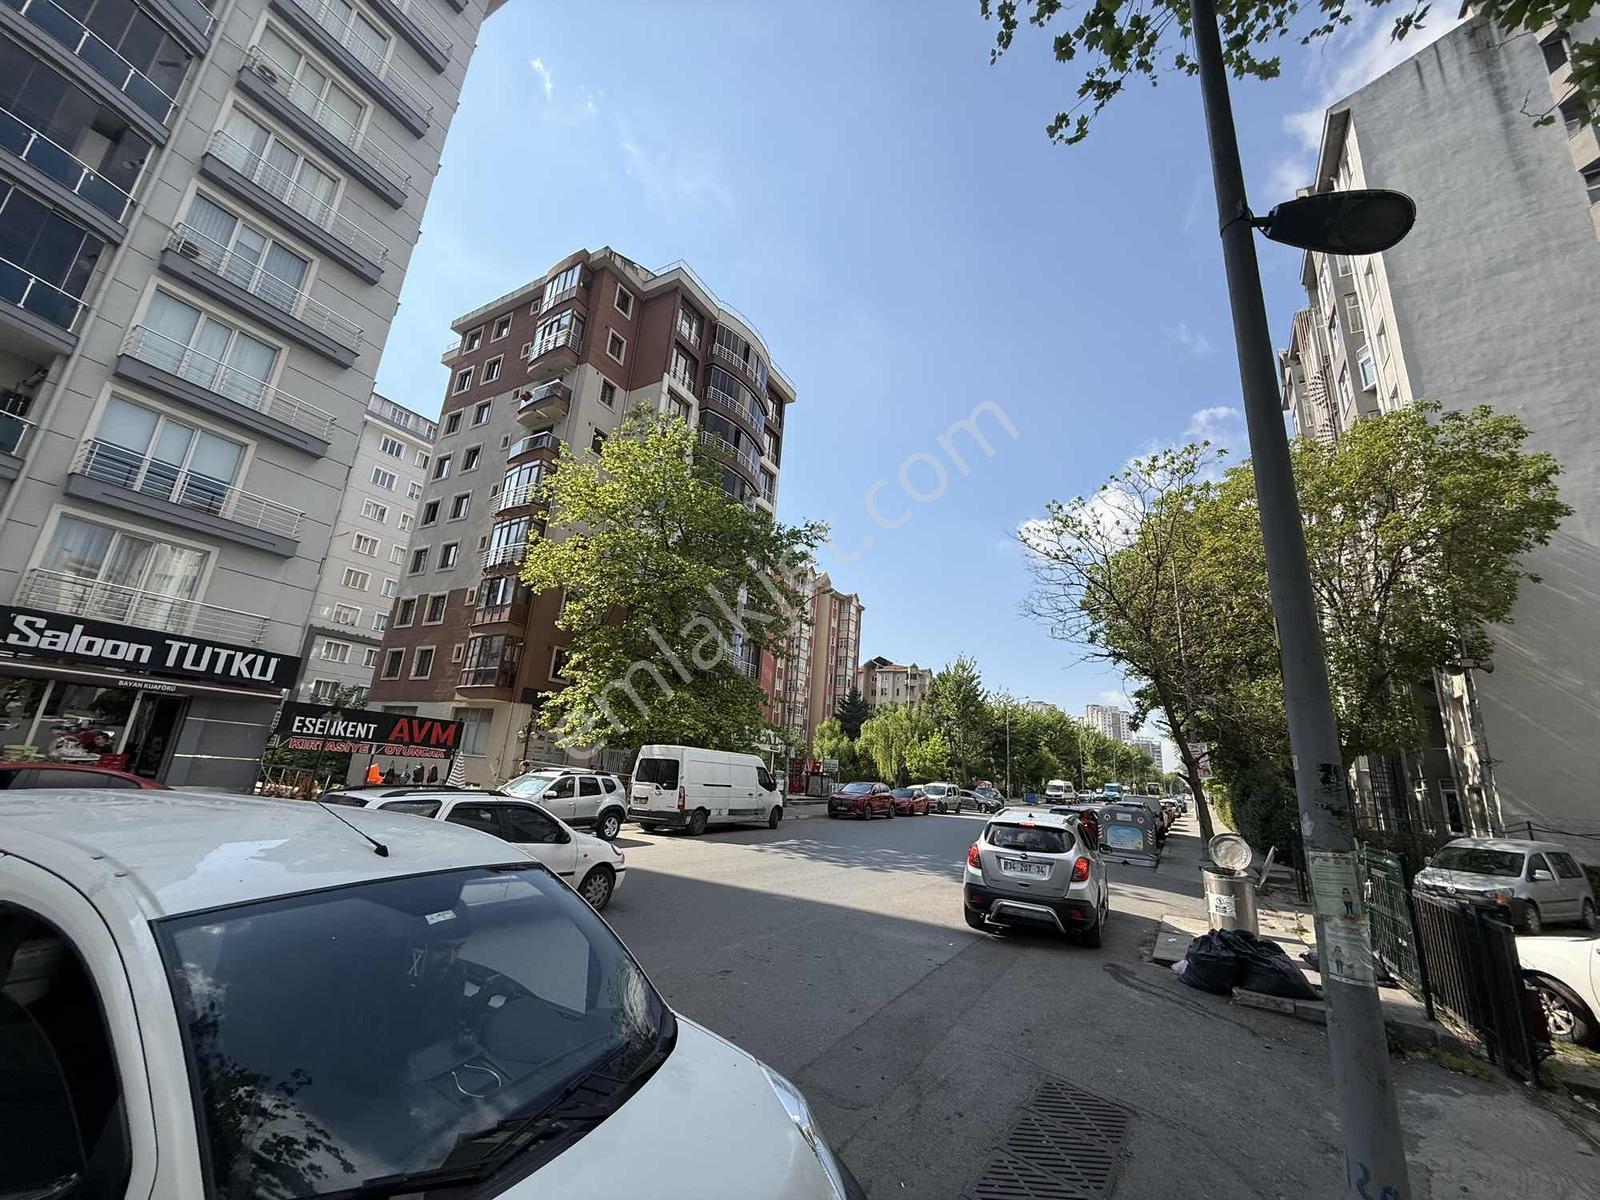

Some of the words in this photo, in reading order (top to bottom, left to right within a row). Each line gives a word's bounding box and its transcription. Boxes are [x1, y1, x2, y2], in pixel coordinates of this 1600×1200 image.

[6, 614, 153, 664] Saloon
[164, 638, 280, 683] TUTKU
[118, 679, 143, 688] BAYAN
[292, 715, 378, 739] ESENKENT
[388, 717, 457, 746] AVM
